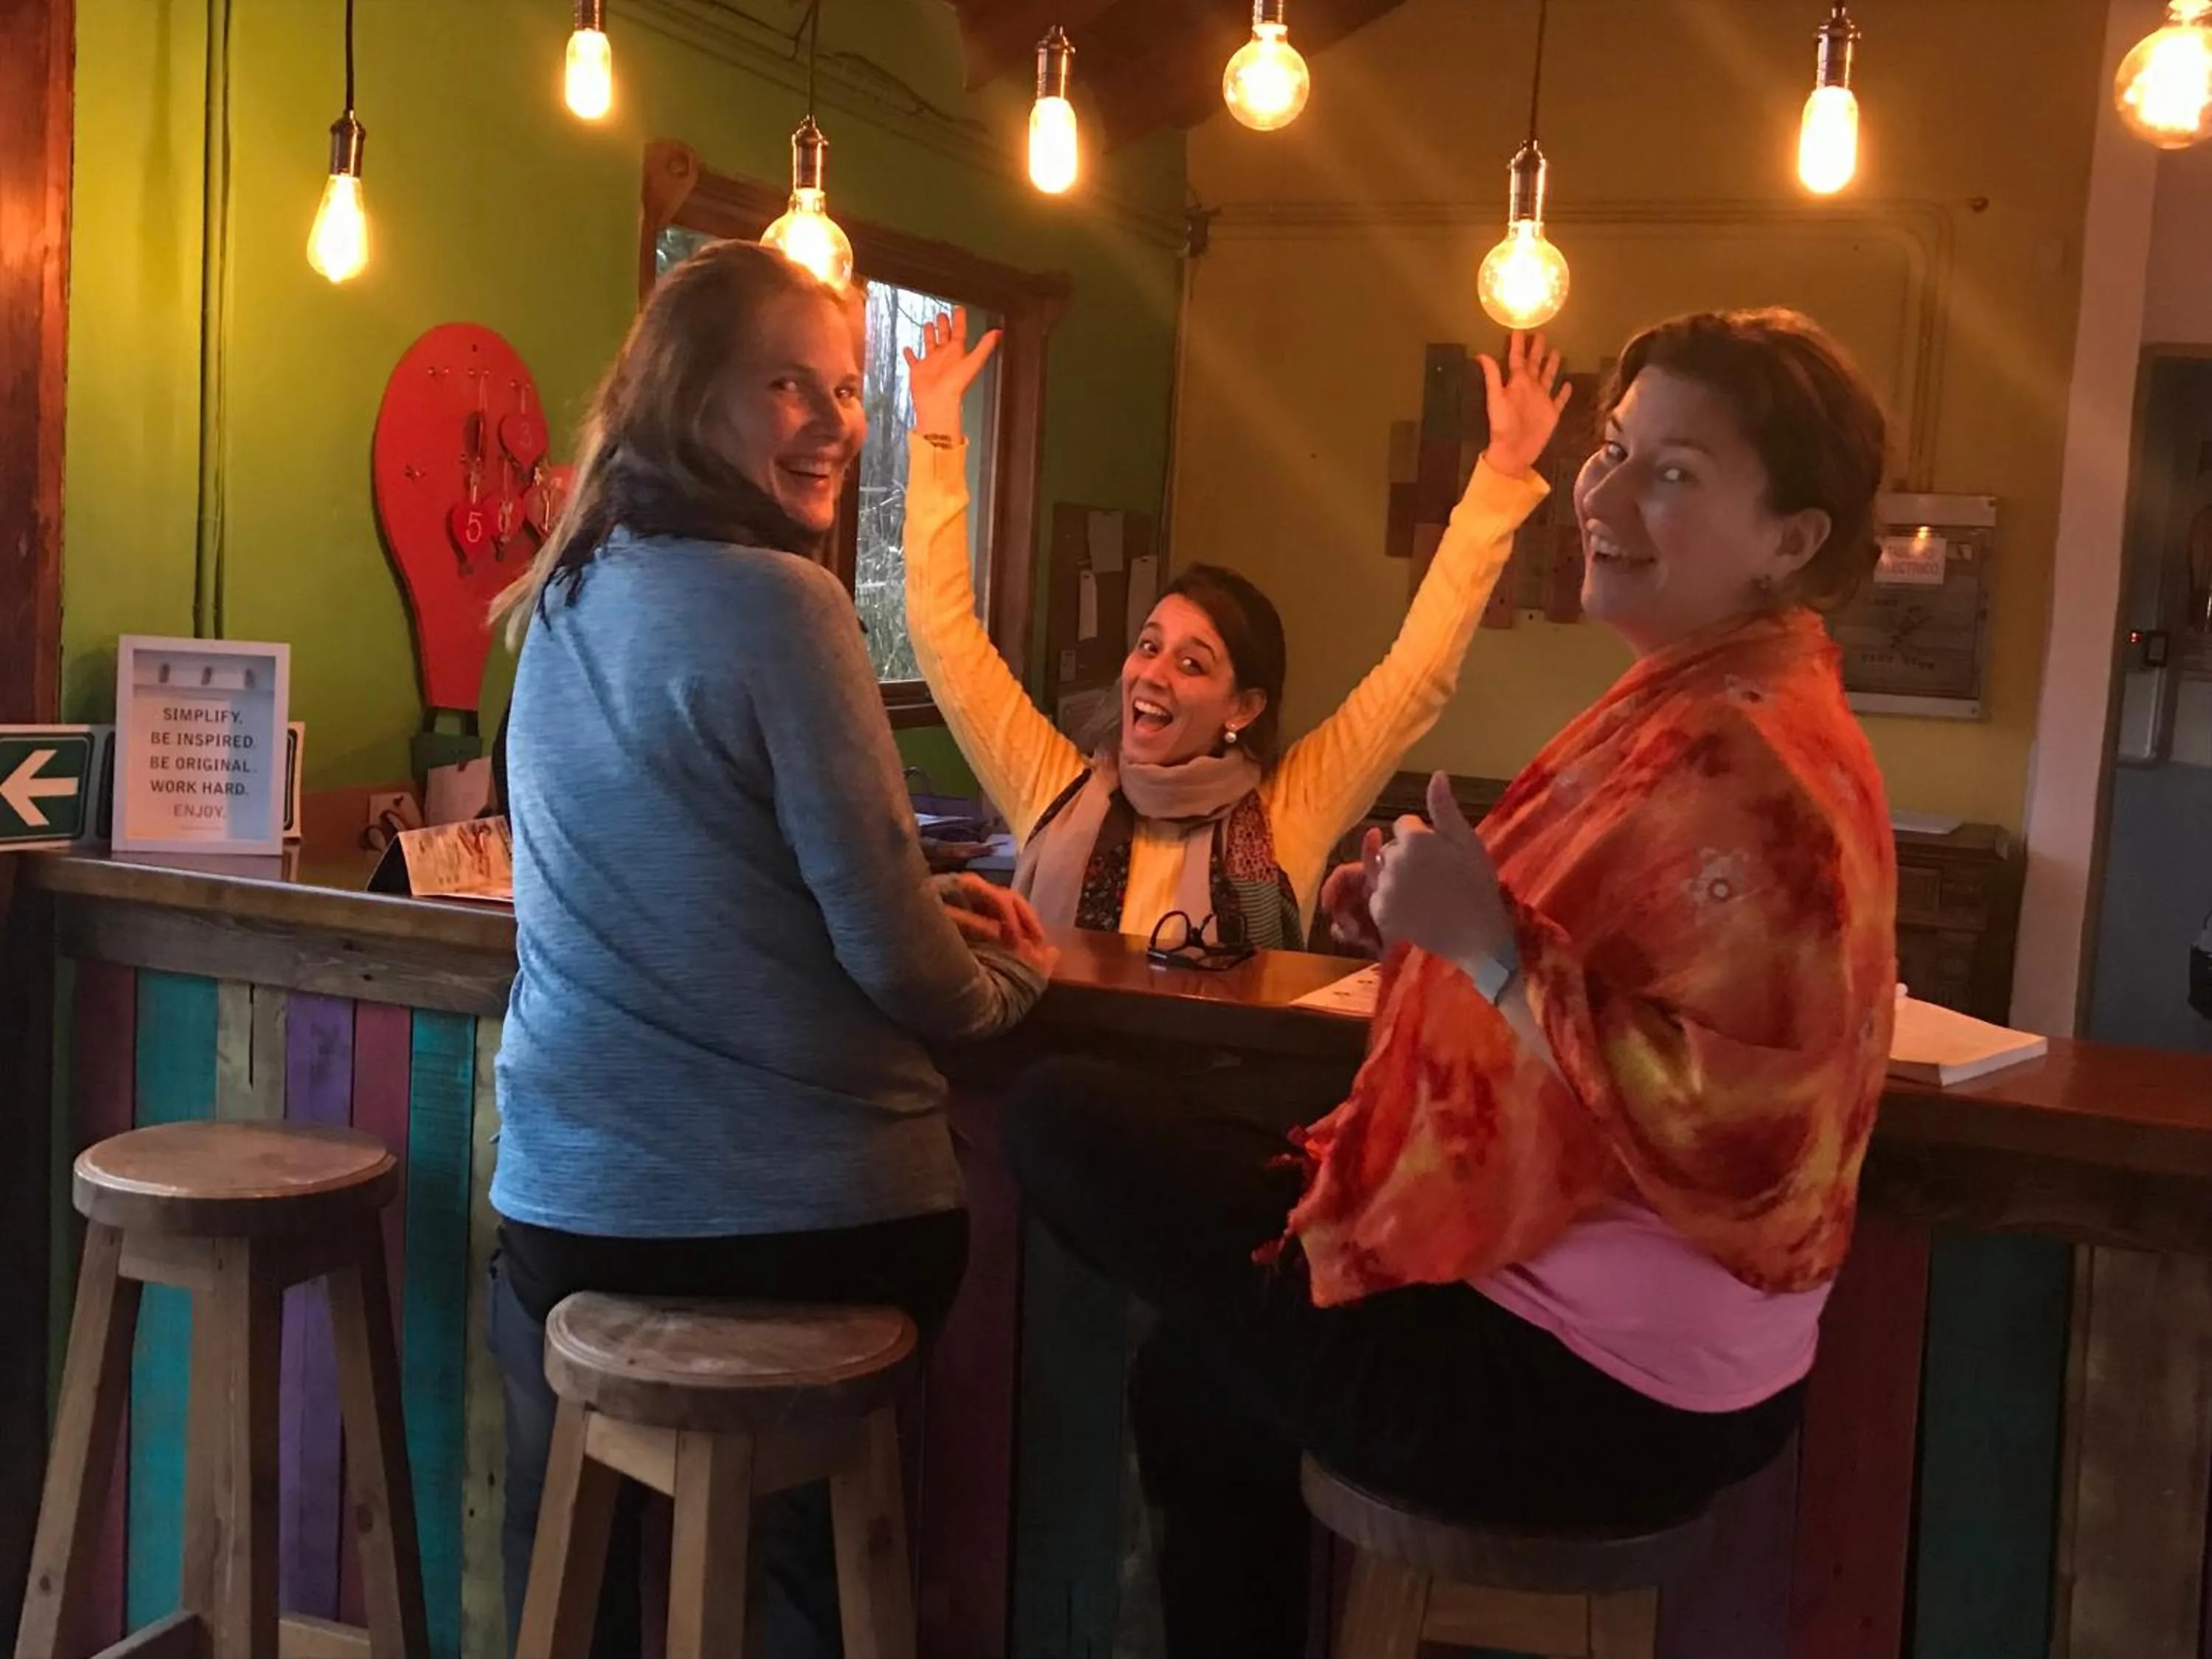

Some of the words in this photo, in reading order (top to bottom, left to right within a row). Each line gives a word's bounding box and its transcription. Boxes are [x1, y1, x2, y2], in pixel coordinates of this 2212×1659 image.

[465, 511, 483, 543] 5
[163, 708, 243, 724] SIMPLIFY.
[150, 731, 171, 745] BE
[150, 756, 170, 770] BE
[150, 779, 197, 793] WORK
